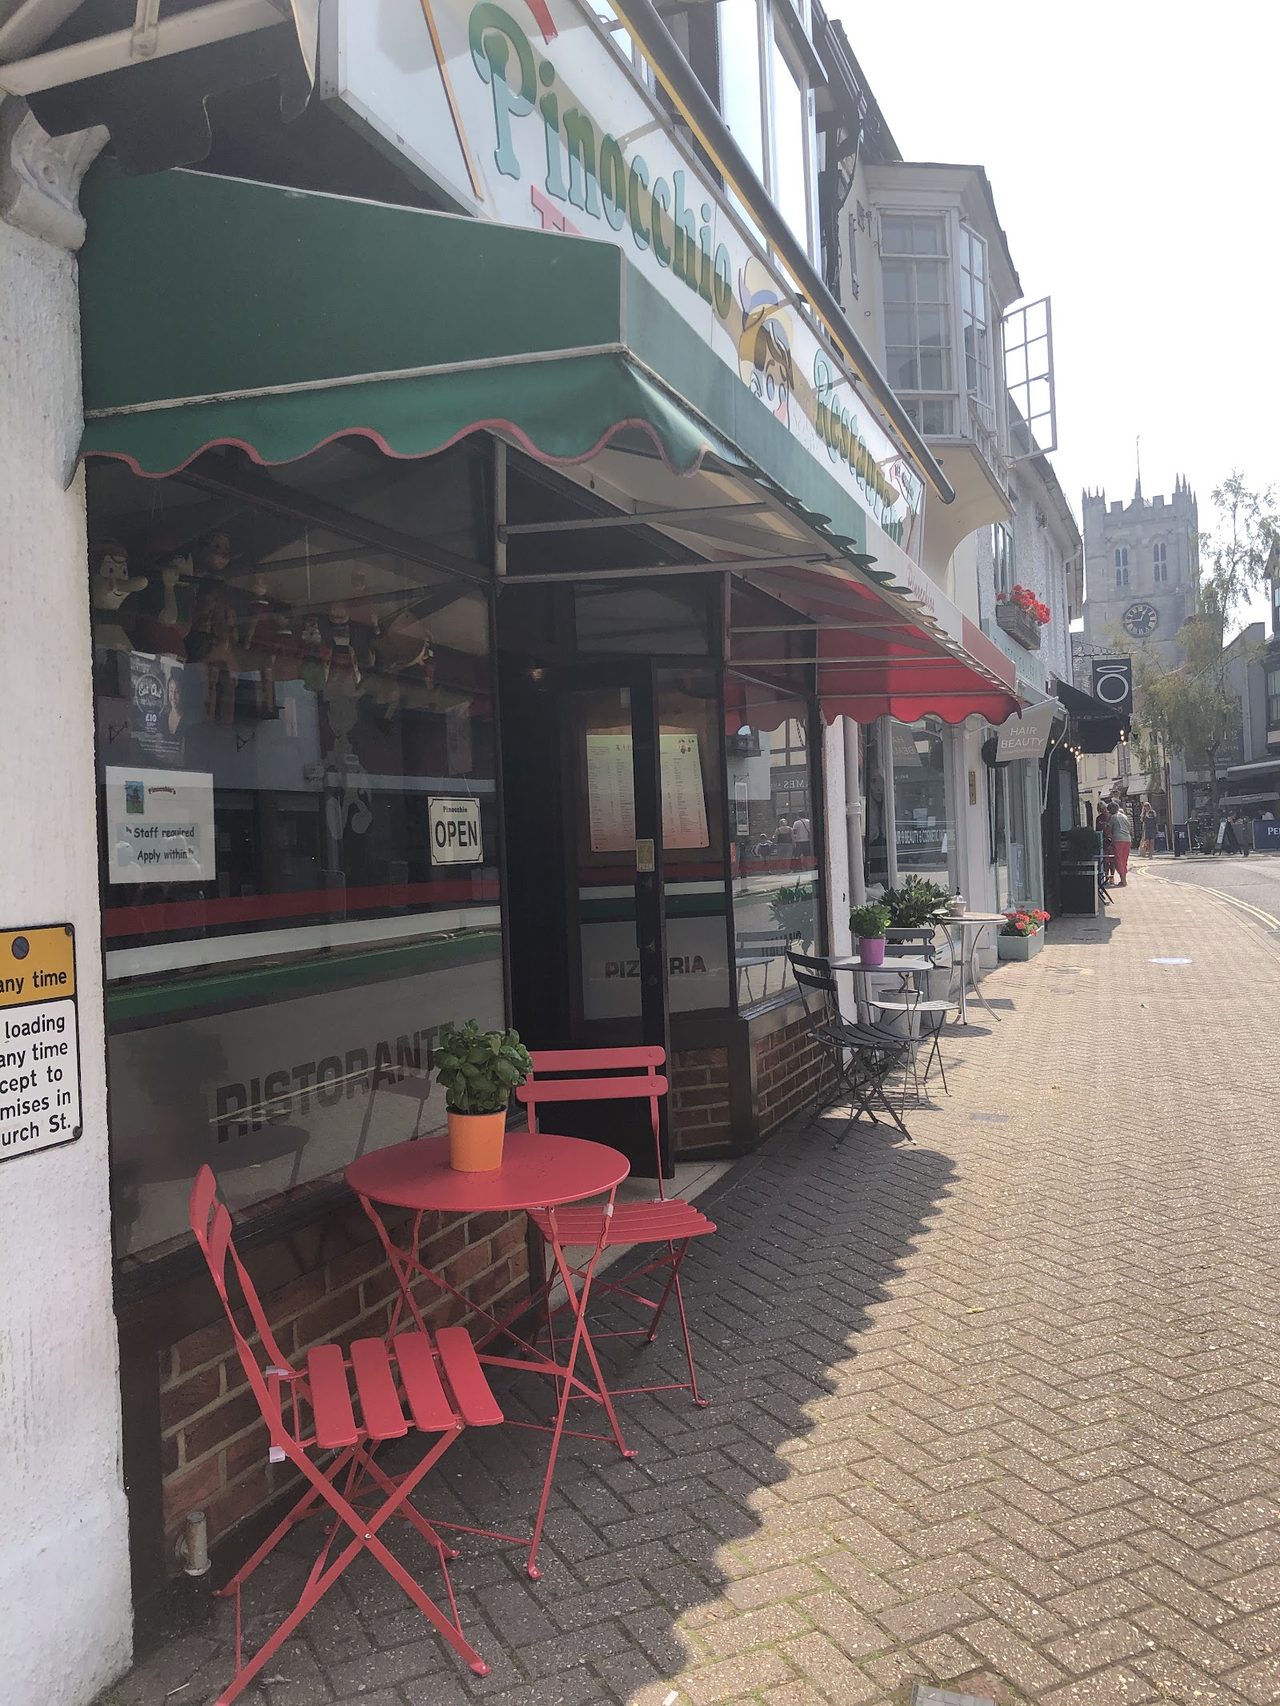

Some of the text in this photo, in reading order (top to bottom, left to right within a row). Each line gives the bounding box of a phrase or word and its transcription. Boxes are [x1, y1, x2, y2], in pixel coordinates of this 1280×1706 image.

[468, 2, 732, 319] Pinocchio
[1010, 726, 1037, 737] HAIR
[1001, 737, 1044, 749] BEAUTY
[134, 826, 195, 840] Staff required
[435, 820, 478, 848] OPEN
[137, 847, 187, 863] Apply within
[605, 955, 706, 978] PIZRIA
[33, 970, 67, 988] time
[6, 1014, 65, 1038] loading
[0, 1041, 68, 1069] any time
[47, 1066, 63, 1084] to
[57, 1089, 71, 1105] in
[49, 1113, 71, 1133] St.
